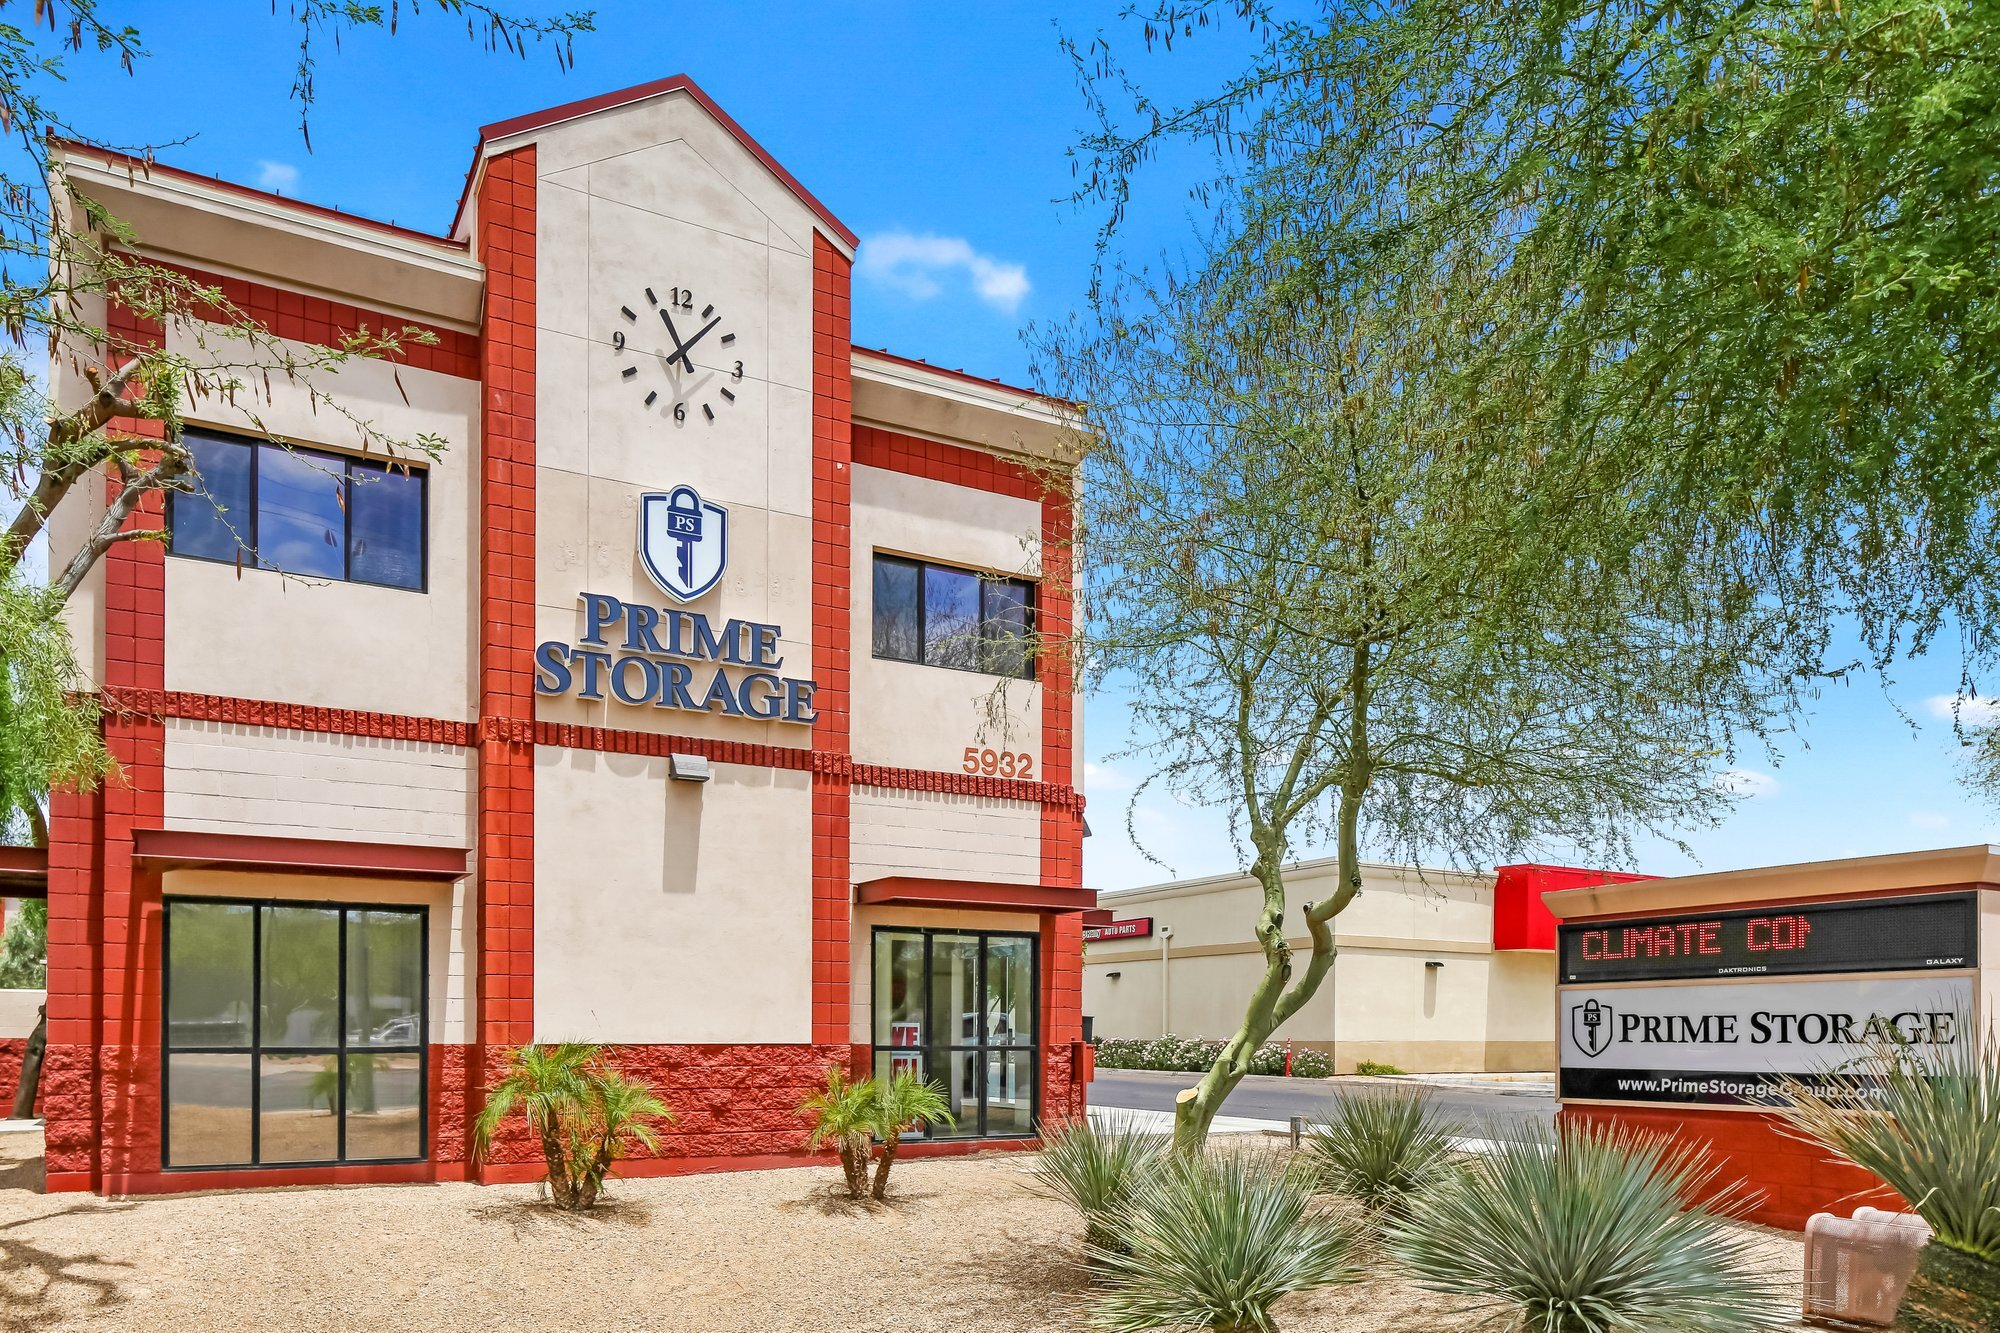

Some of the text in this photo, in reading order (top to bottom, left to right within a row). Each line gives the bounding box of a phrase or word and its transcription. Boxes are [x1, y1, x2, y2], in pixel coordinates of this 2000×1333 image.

[670, 286, 693, 309] 12
[613, 331, 626, 350] 9
[732, 360, 744, 378] 3
[673, 402, 686, 421] 6
[675, 515, 695, 532] PS
[578, 592, 784, 670] PRIME
[534, 641, 819, 725] STORAGE
[962, 747, 1033, 779] 5932
[1104, 928, 1118, 936] AUTO
[1119, 925, 1136, 934] PARTS
[1582, 922, 1721, 960] CLIMATE
[1718, 966, 1767, 974] DAKTRONICS
[1926, 957, 1963, 966] GALAXY
[1587, 1013, 1598, 1022] PS
[1618, 1011, 1956, 1046] PRIME STORAGE
